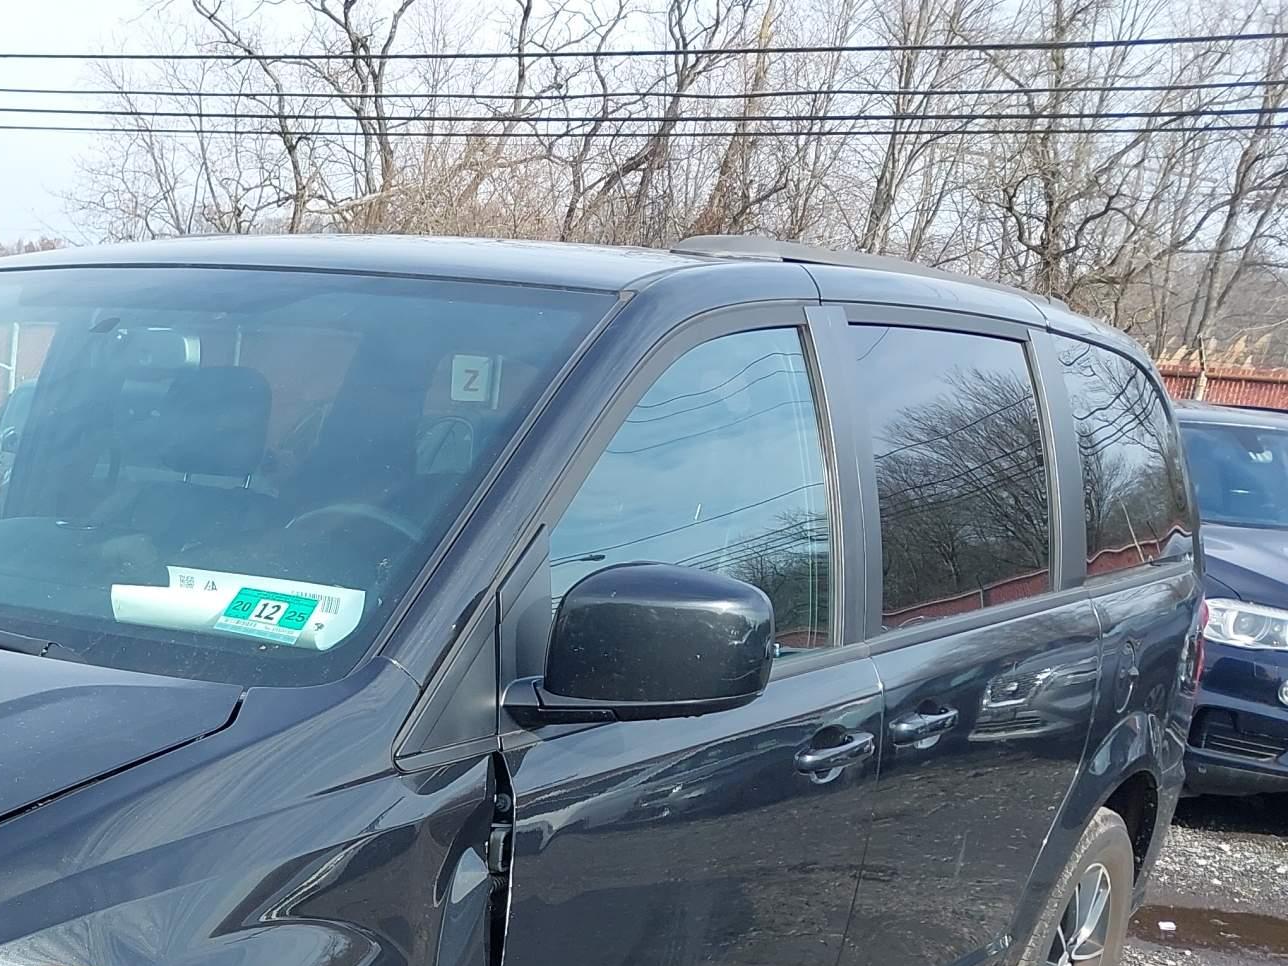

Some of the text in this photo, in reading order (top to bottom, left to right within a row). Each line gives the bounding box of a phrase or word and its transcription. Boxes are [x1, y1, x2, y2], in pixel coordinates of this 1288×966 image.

[463, 369, 479, 392] Z
[232, 600, 305, 622] 20 12 25
